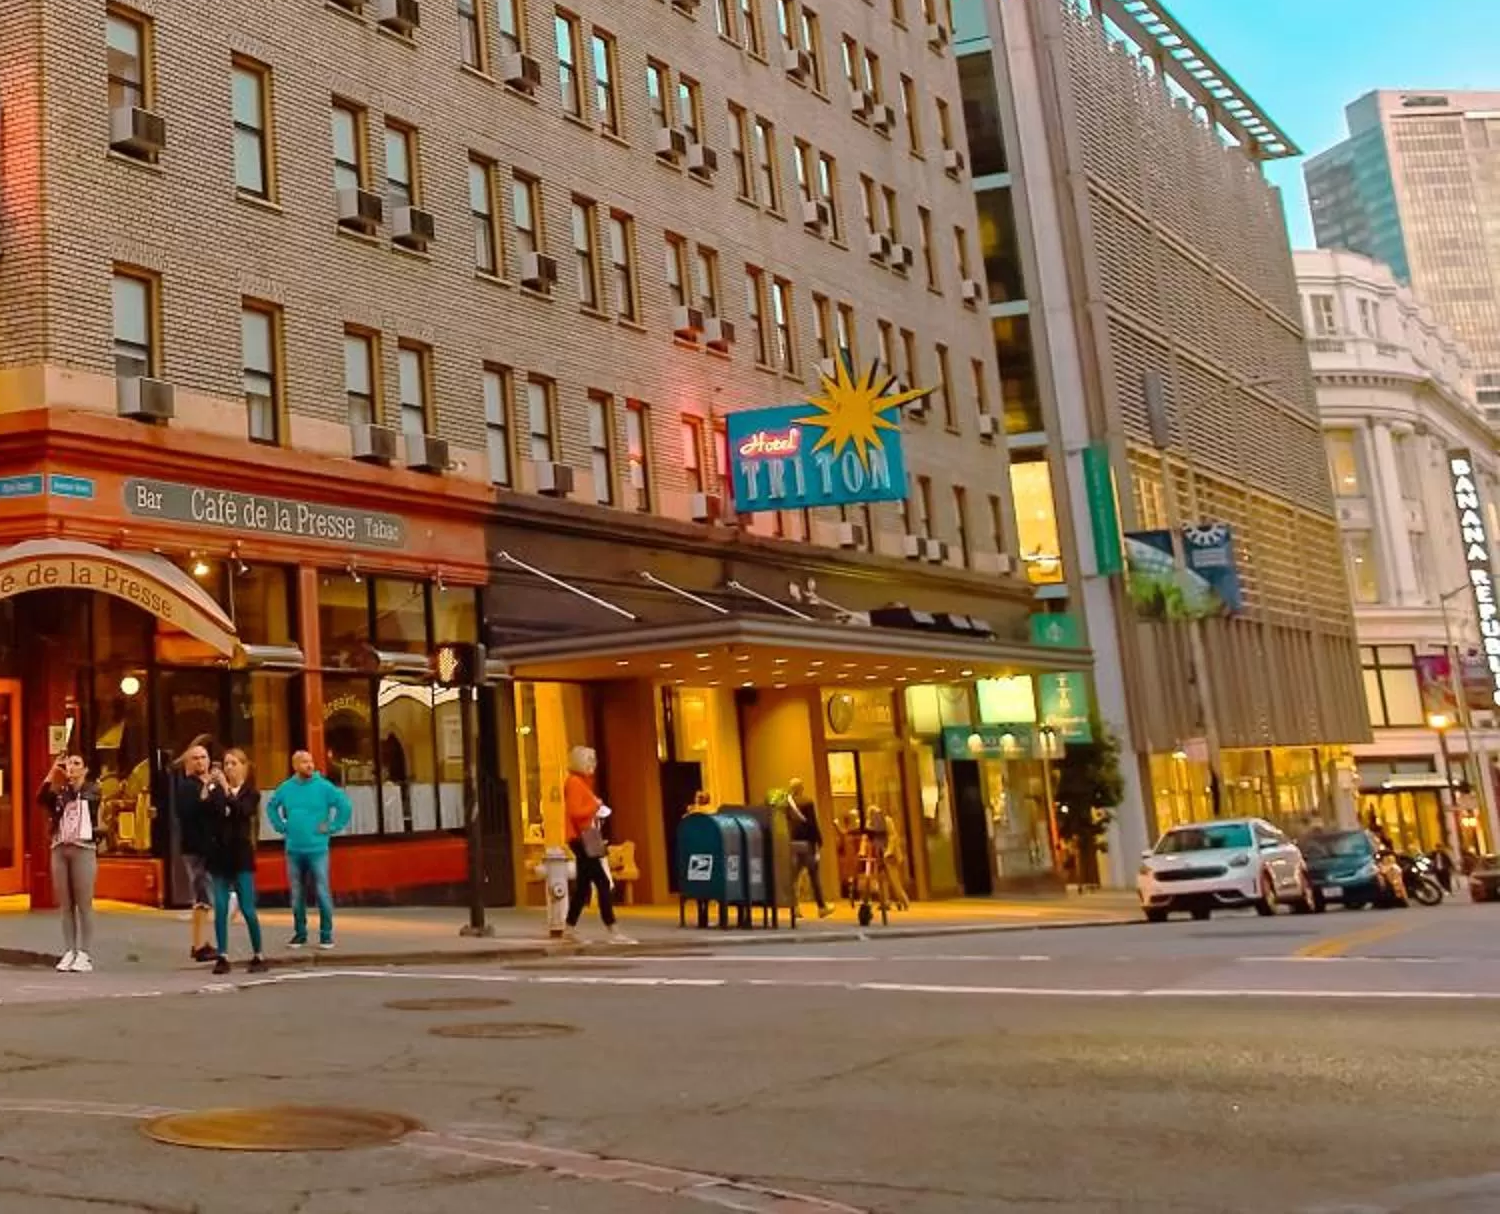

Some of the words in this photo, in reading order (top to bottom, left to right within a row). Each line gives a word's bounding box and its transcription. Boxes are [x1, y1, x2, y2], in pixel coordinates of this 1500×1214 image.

[739, 428, 800, 456] Hotel
[740, 449, 891, 500] TRITON
[136, 485, 163, 510] Bar
[243, 497, 269, 530] de
[274, 501, 293, 532] la
[296, 504, 357, 540] Presse
[1451, 458, 1489, 562] BANANA
[26, 563, 60, 585] de
[70, 561, 93, 585] la
[104, 565, 173, 619] Presse
